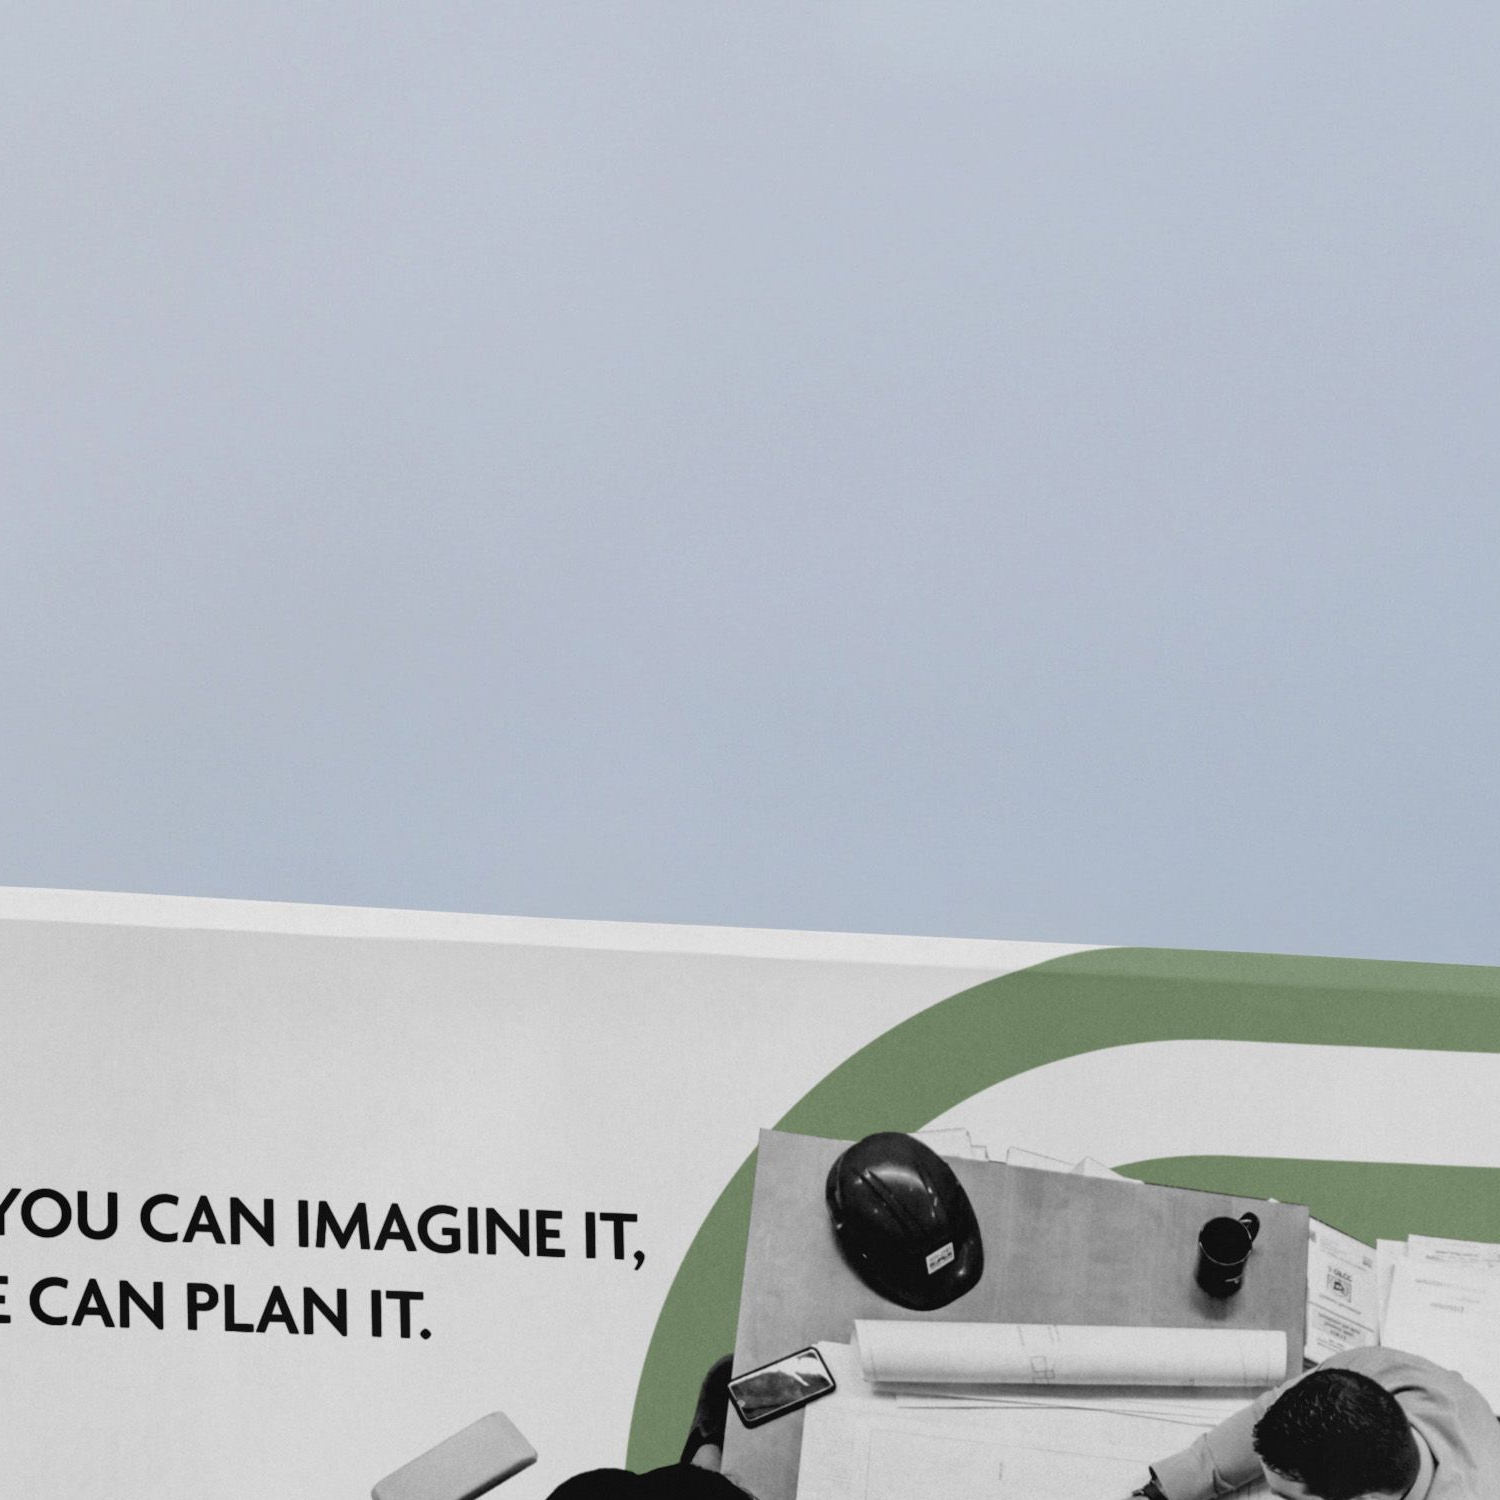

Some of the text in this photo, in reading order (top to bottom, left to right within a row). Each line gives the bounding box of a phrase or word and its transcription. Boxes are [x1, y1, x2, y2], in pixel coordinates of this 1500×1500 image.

[139, 1193, 275, 1247] CAN
[297, 1199, 566, 1258] IMAGINE
[585, 1211, 647, 1271] IT,
[29, 1276, 164, 1331] CAN
[186, 1282, 348, 1337] PLAN
[370, 1289, 432, 1340] IT.
